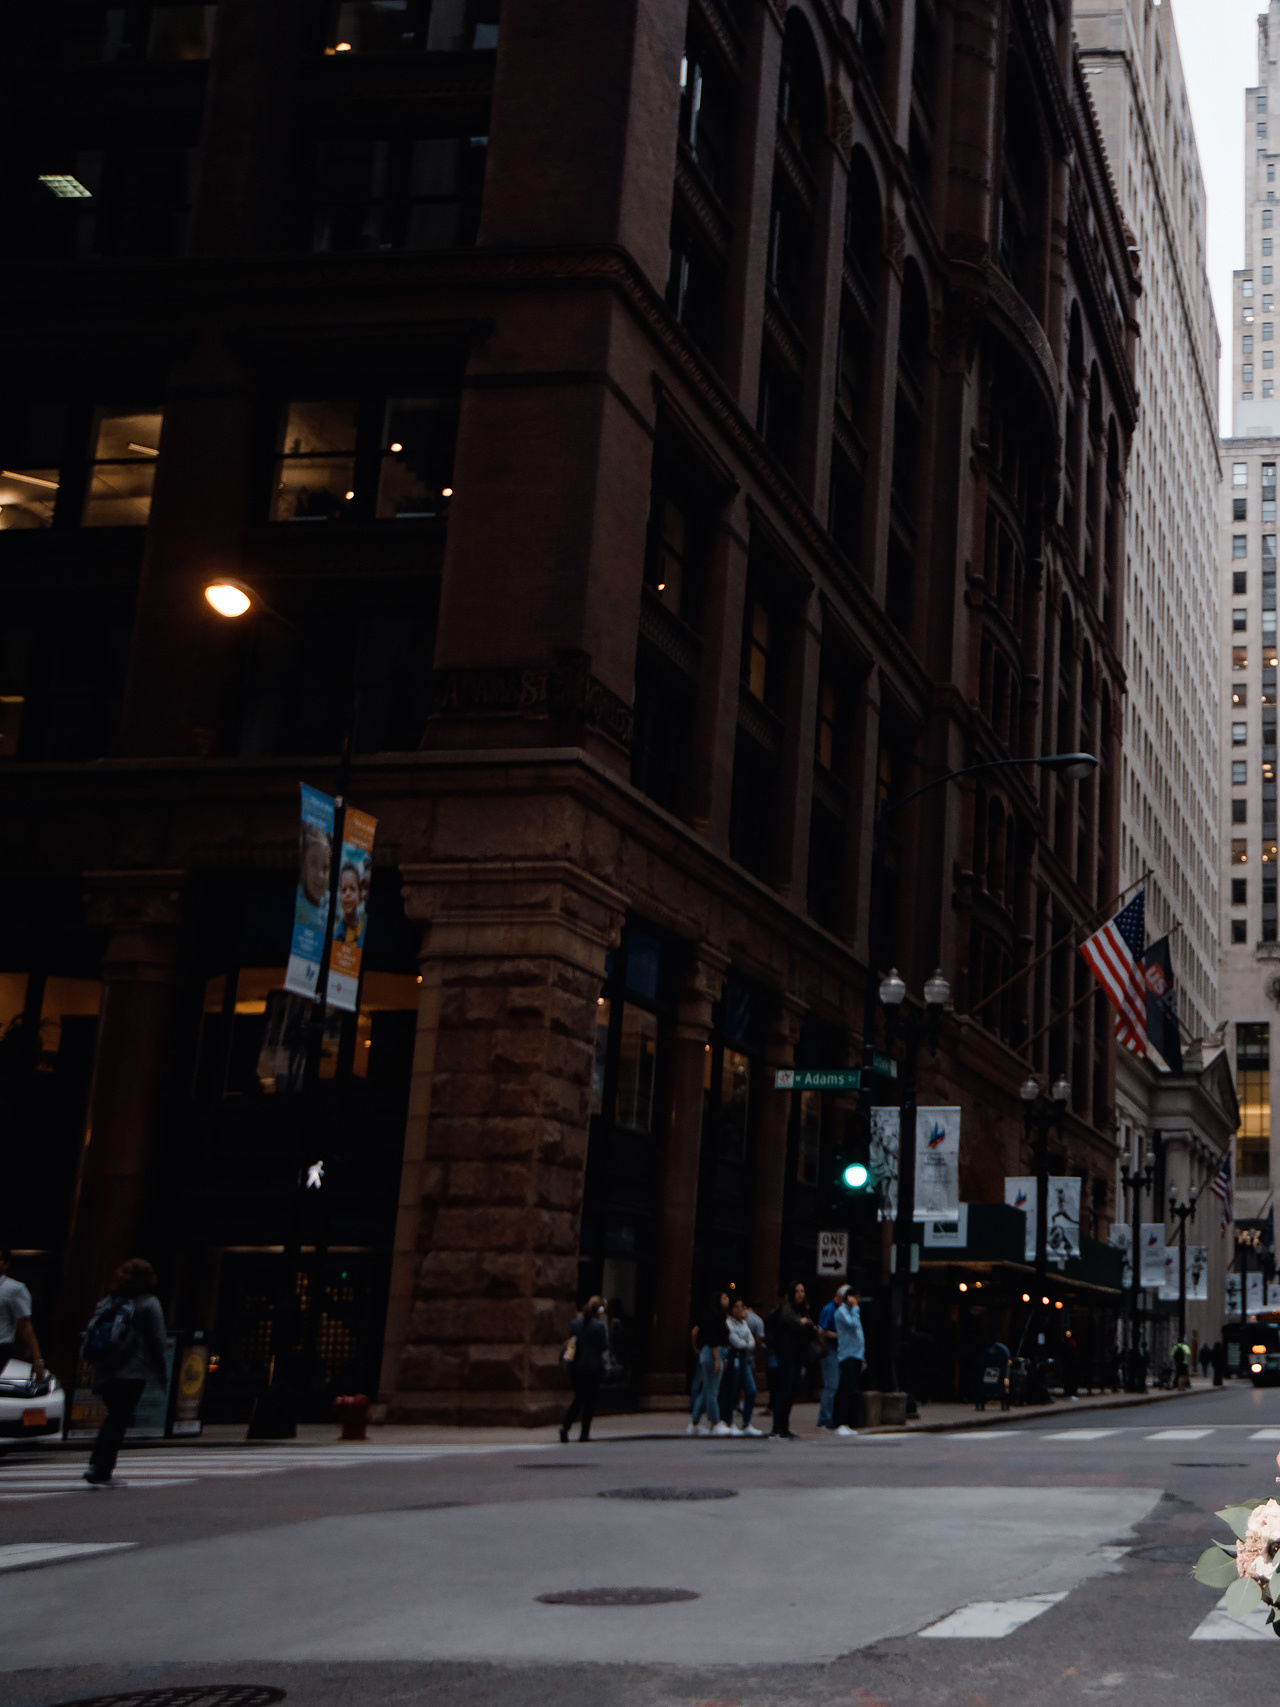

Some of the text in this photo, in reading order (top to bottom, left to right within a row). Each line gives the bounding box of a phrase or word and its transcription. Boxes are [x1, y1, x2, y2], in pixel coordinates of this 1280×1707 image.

[804, 1072, 845, 1085] Adams
[822, 1234, 844, 1246] ONE
[822, 1247, 846, 1257] WAY
